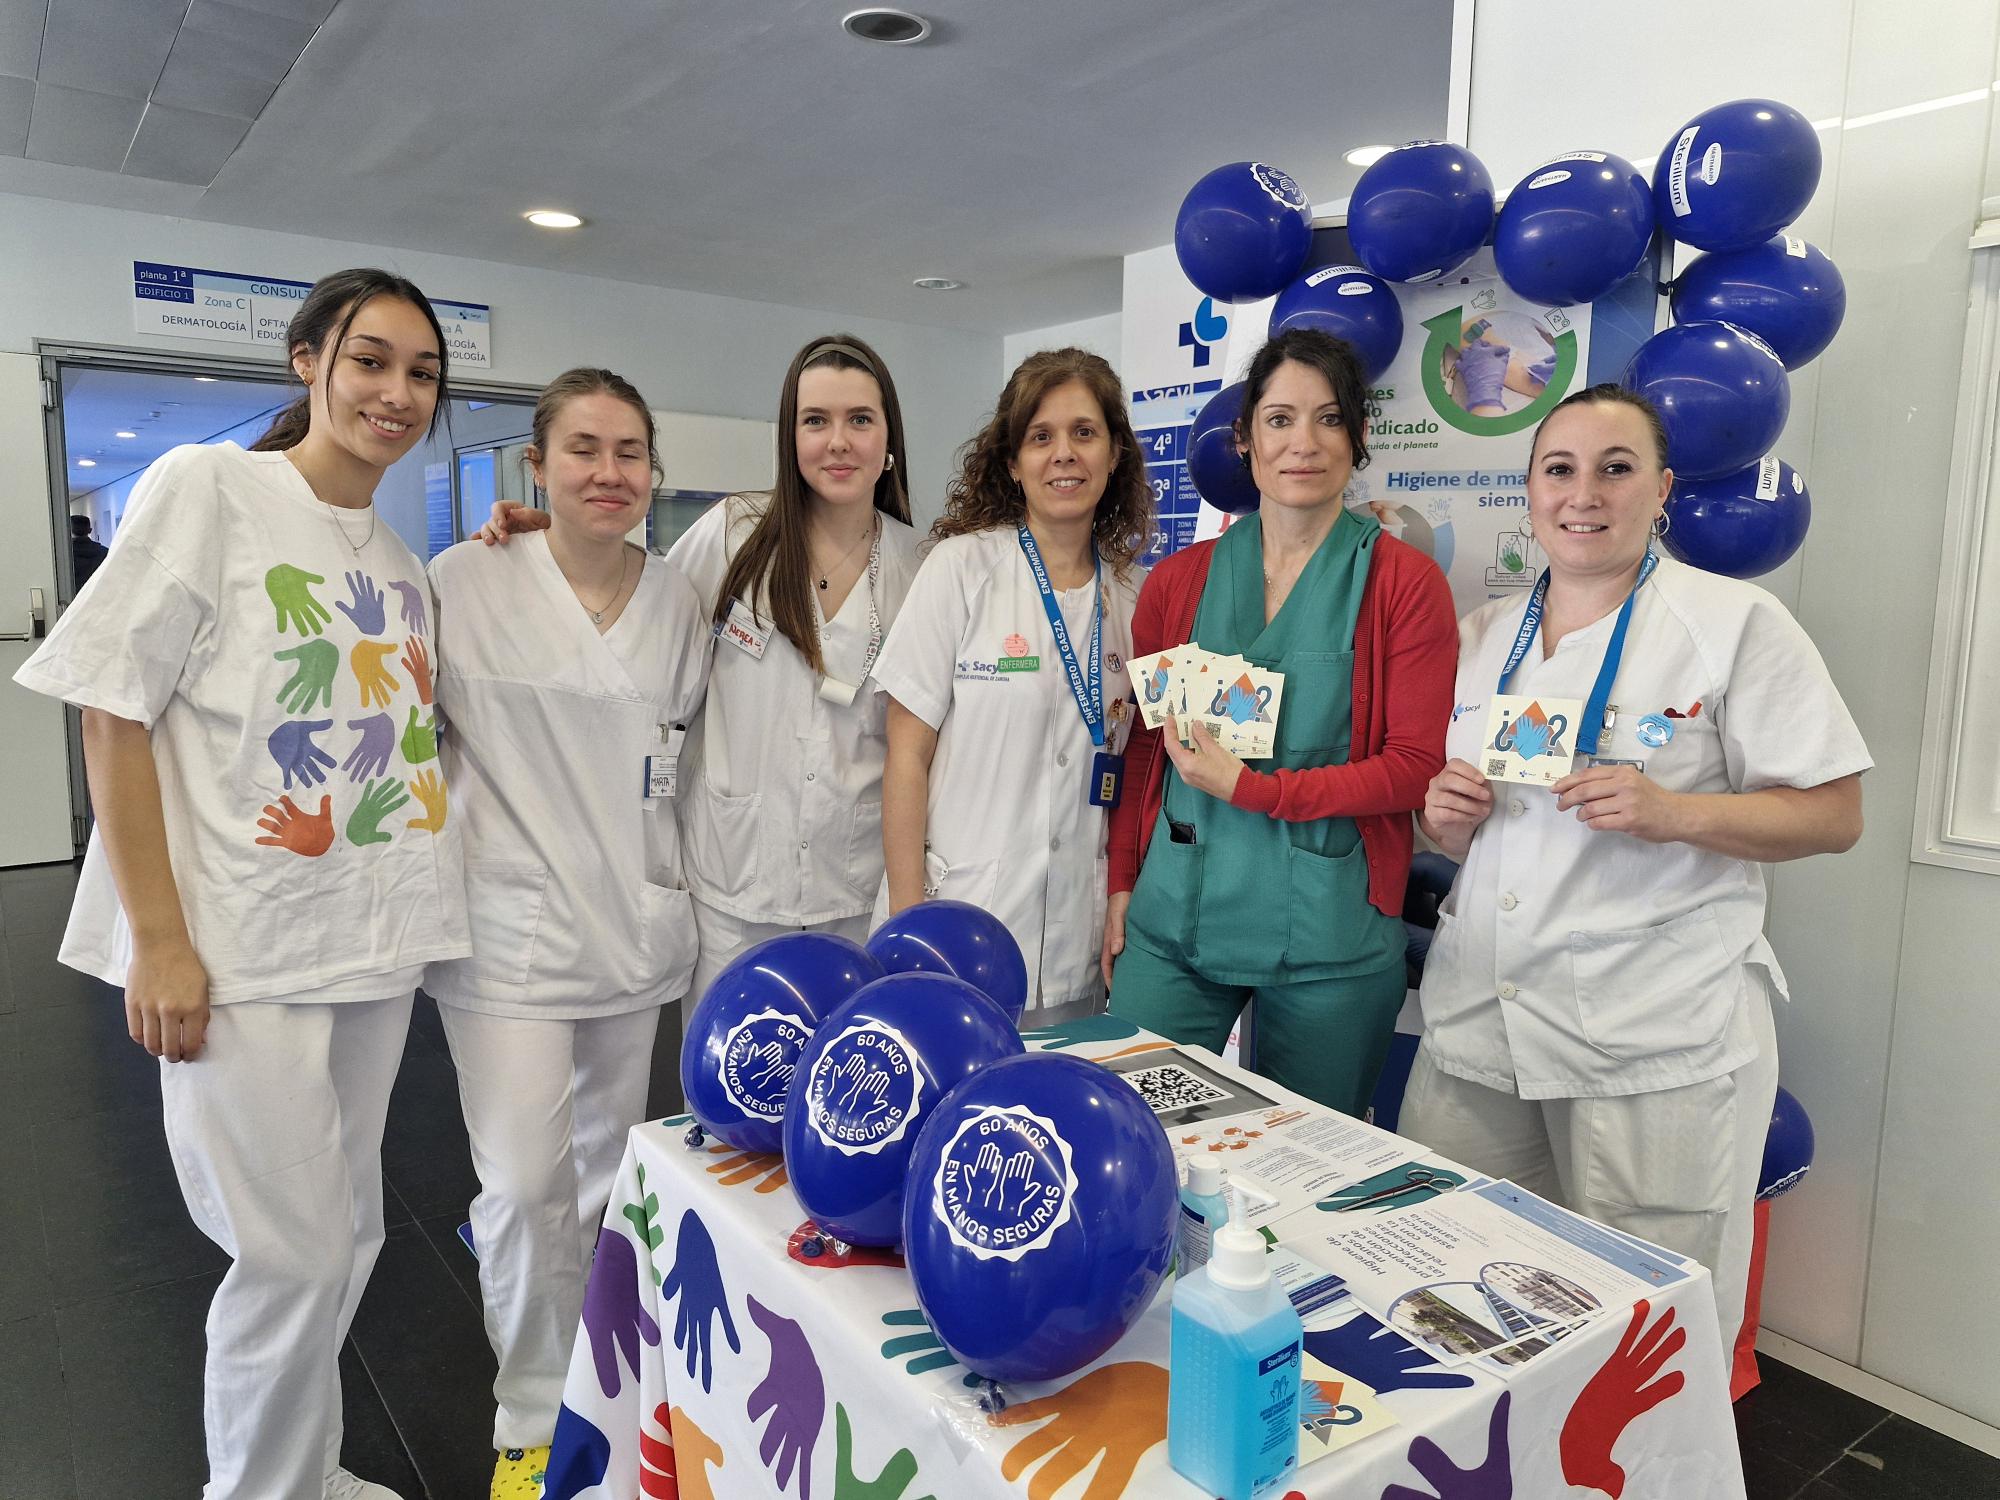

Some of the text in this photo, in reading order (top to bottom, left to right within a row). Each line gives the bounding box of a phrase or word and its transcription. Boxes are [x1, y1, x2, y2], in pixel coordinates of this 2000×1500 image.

[1709, 146, 1717, 182] HARTMANN
[140, 269, 187, 282] planta 1ª
[138, 287, 190, 300] EDIFICIO 1
[204, 296, 246, 310] Zona C
[162, 314, 247, 332] DERMATOLOGÍA
[454, 324, 463, 335] A
[1153, 432, 1172, 456] 4ª
[1392, 441, 1401, 449] el
[1403, 440, 1439, 452] planeta
[1152, 478, 1171, 502] 3ª
[1387, 471, 1461, 492] Higiene
[1466, 470, 1491, 487] de
[1150, 532, 1169, 554] 2ª
[729, 622, 754, 646] NEREA
[1053, 618, 1070, 653] GASZA
[1000, 659, 1038, 669] ENFERMERA
[736, 1029, 754, 1047] EN
[778, 1024, 796, 1040] 60
[857, 1034, 908, 1075] 60 AÑOS
[728, 1045, 745, 1095] MANOS
[814, 1056, 902, 1141] EN MANOS SEGURAS
[979, 1118, 1049, 1150] 60 AÑOS
[945, 1160, 1061, 1244] EN MANOS SEGURAS
[1386, 1219, 1422, 1241] con la
[1398, 1216, 1456, 1250] asistencia
[1409, 1213, 1460, 1243] sanitaria
[1326, 1236, 1387, 1276] Higiene de
[1347, 1239, 1386, 1264] manos
[1350, 1229, 1433, 1279] prevención de
[1362, 1225, 1447, 1278] las infecciones
[1374, 1223, 1447, 1267] relacionadas
